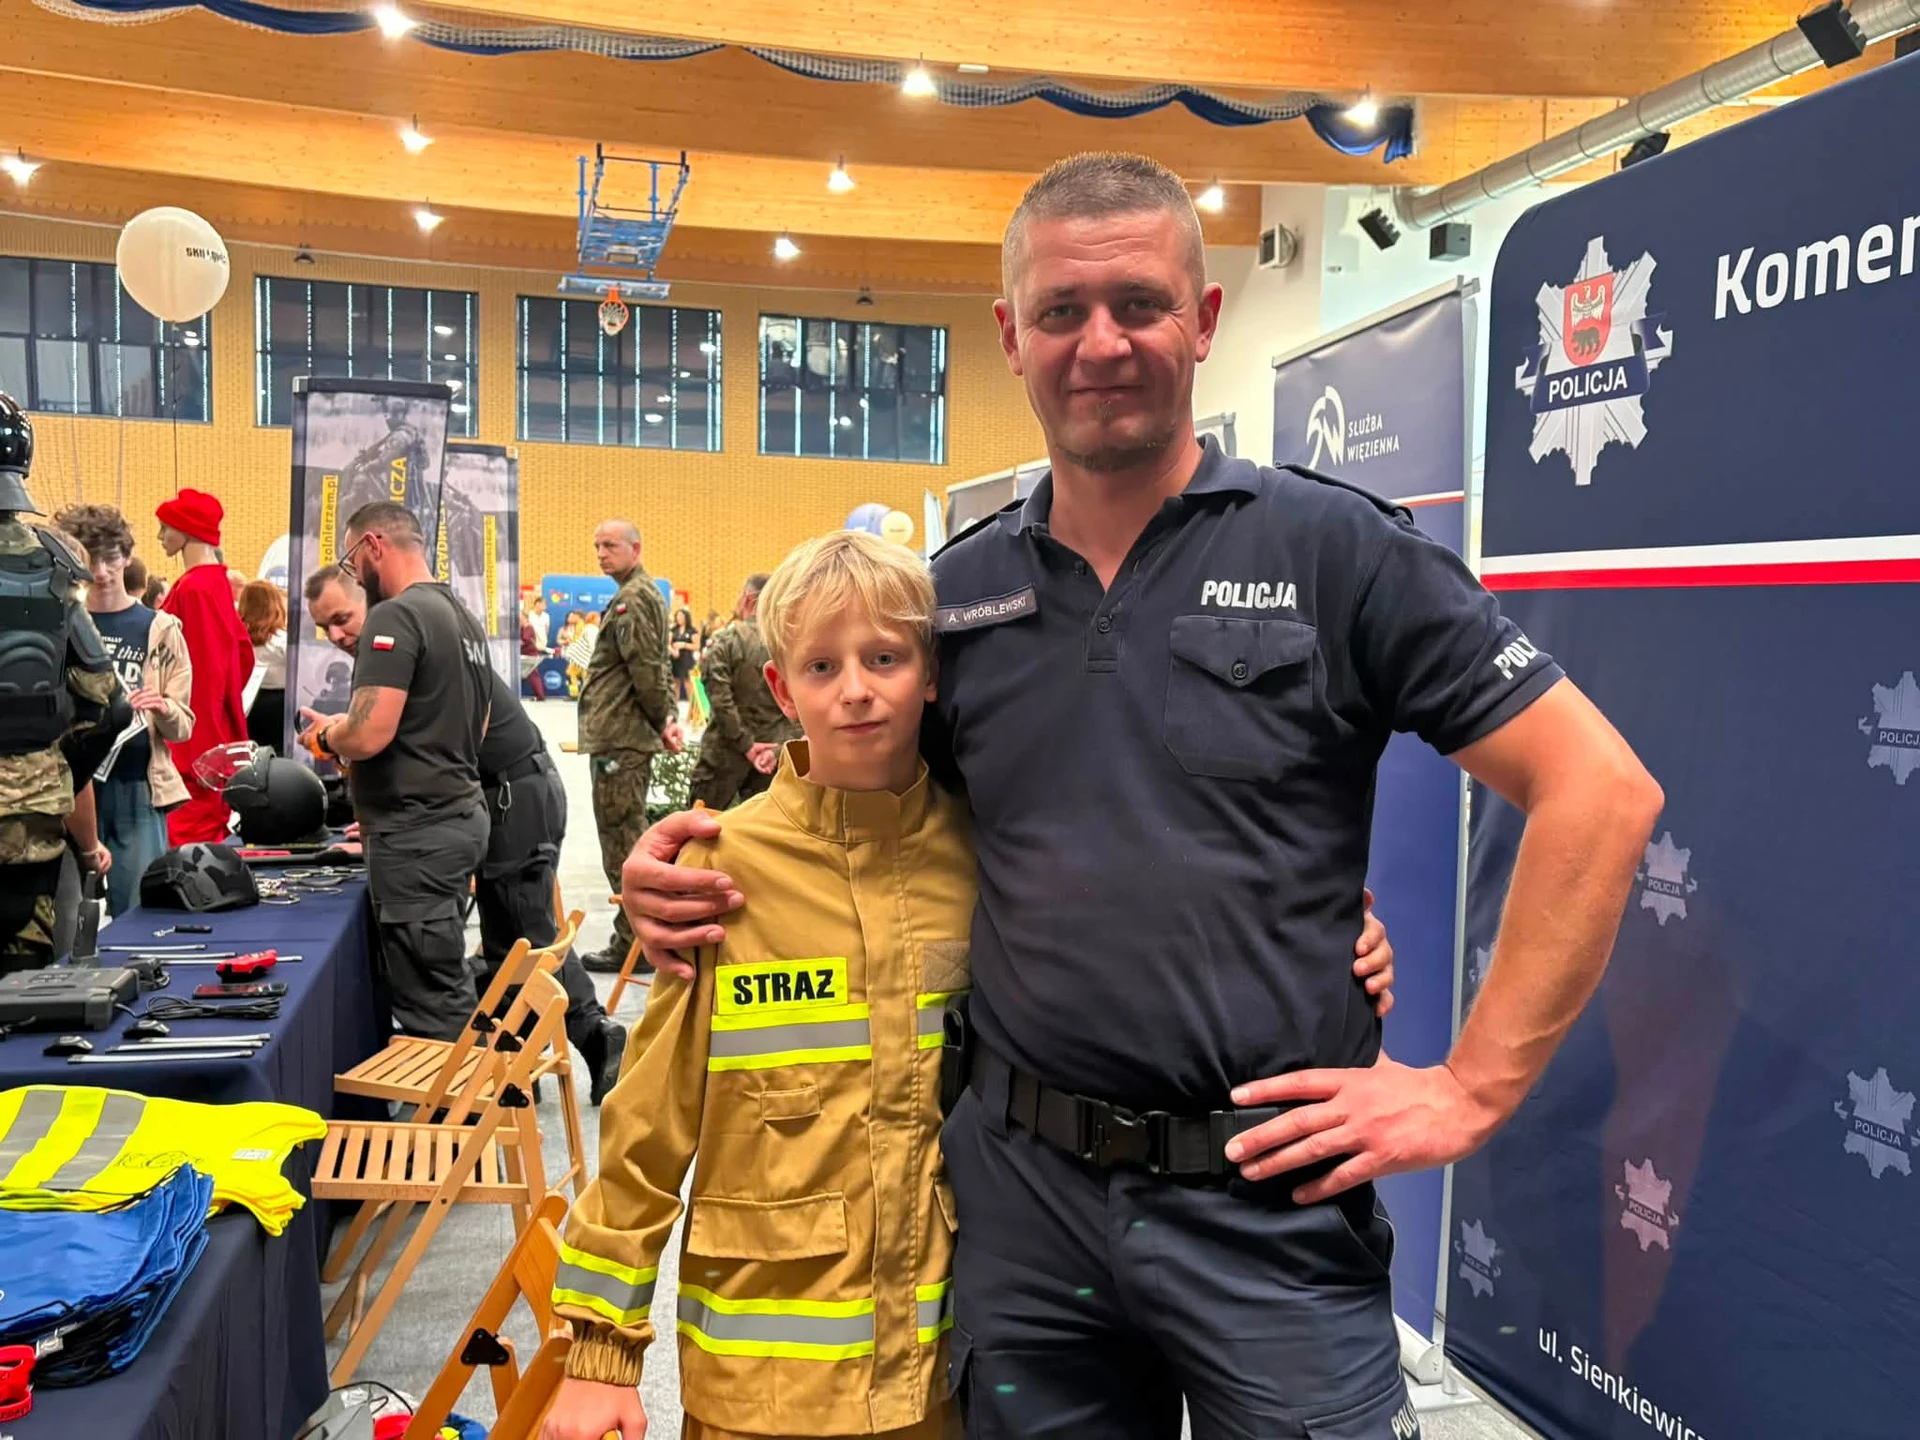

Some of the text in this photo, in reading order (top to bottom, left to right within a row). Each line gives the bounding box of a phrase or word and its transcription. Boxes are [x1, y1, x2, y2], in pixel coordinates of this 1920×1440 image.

[1549, 366, 1628, 403] POLICJA
[1348, 412, 1383, 438] SŁUŻBA
[1347, 434, 1400, 463] WIĘZIENNA
[1201, 580, 1297, 609] POLICJA
[948, 596, 1027, 623] A. WRÓBLEWSKI
[117, 645, 145, 661] this
[1493, 633, 1538, 680] POLI
[1880, 731, 1920, 745] POLICJ
[1648, 879, 1681, 896] POLICJA
[1855, 1119, 1901, 1147] POLICJA
[1539, 1327, 1706, 1440] ul. Sienkiewi
